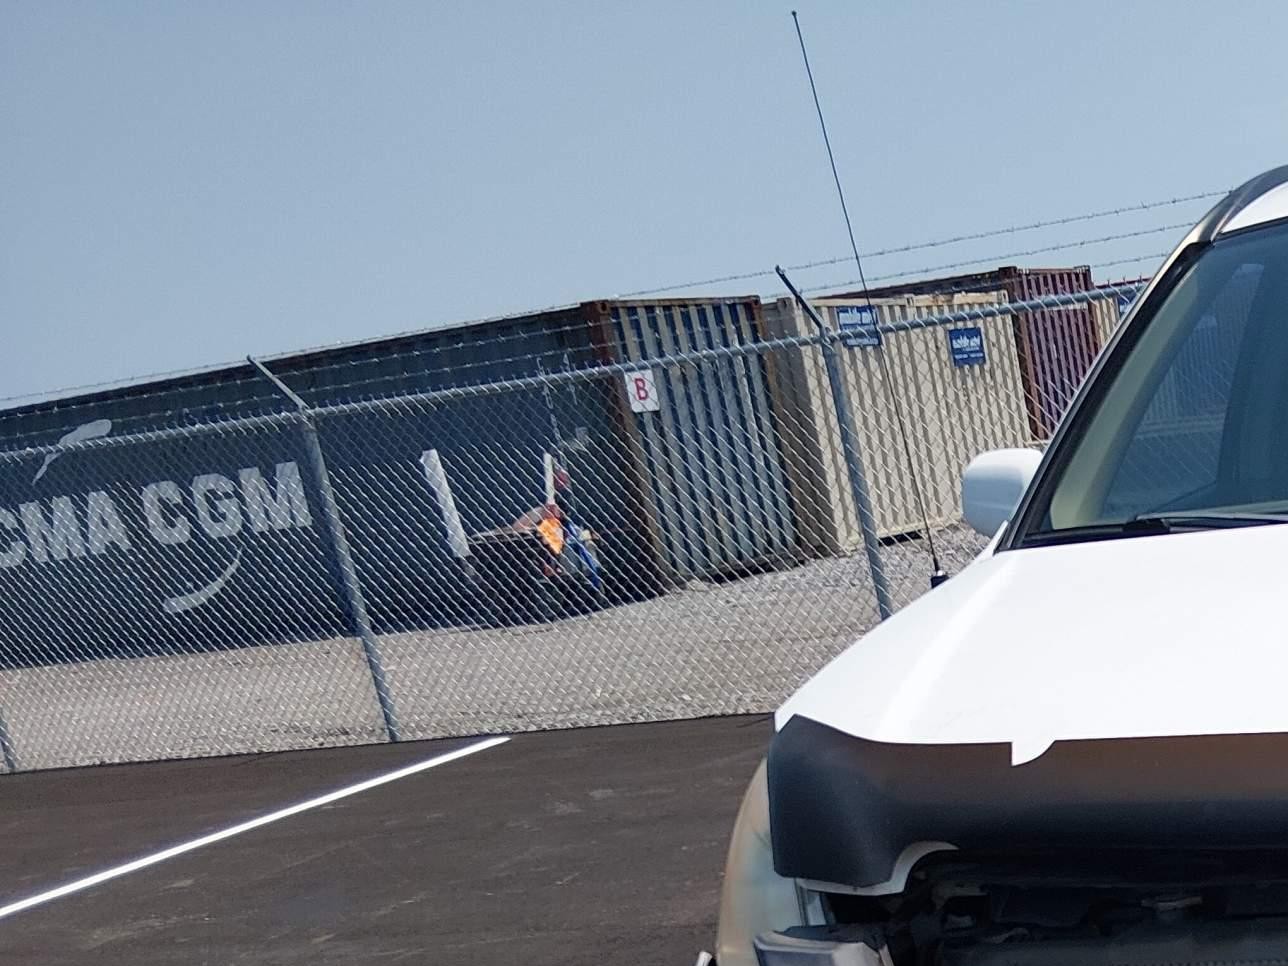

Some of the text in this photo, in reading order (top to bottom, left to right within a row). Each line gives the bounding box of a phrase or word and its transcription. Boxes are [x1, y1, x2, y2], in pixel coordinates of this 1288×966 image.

[634, 377, 649, 401] B
[0, 461, 312, 568] CMA CGM
